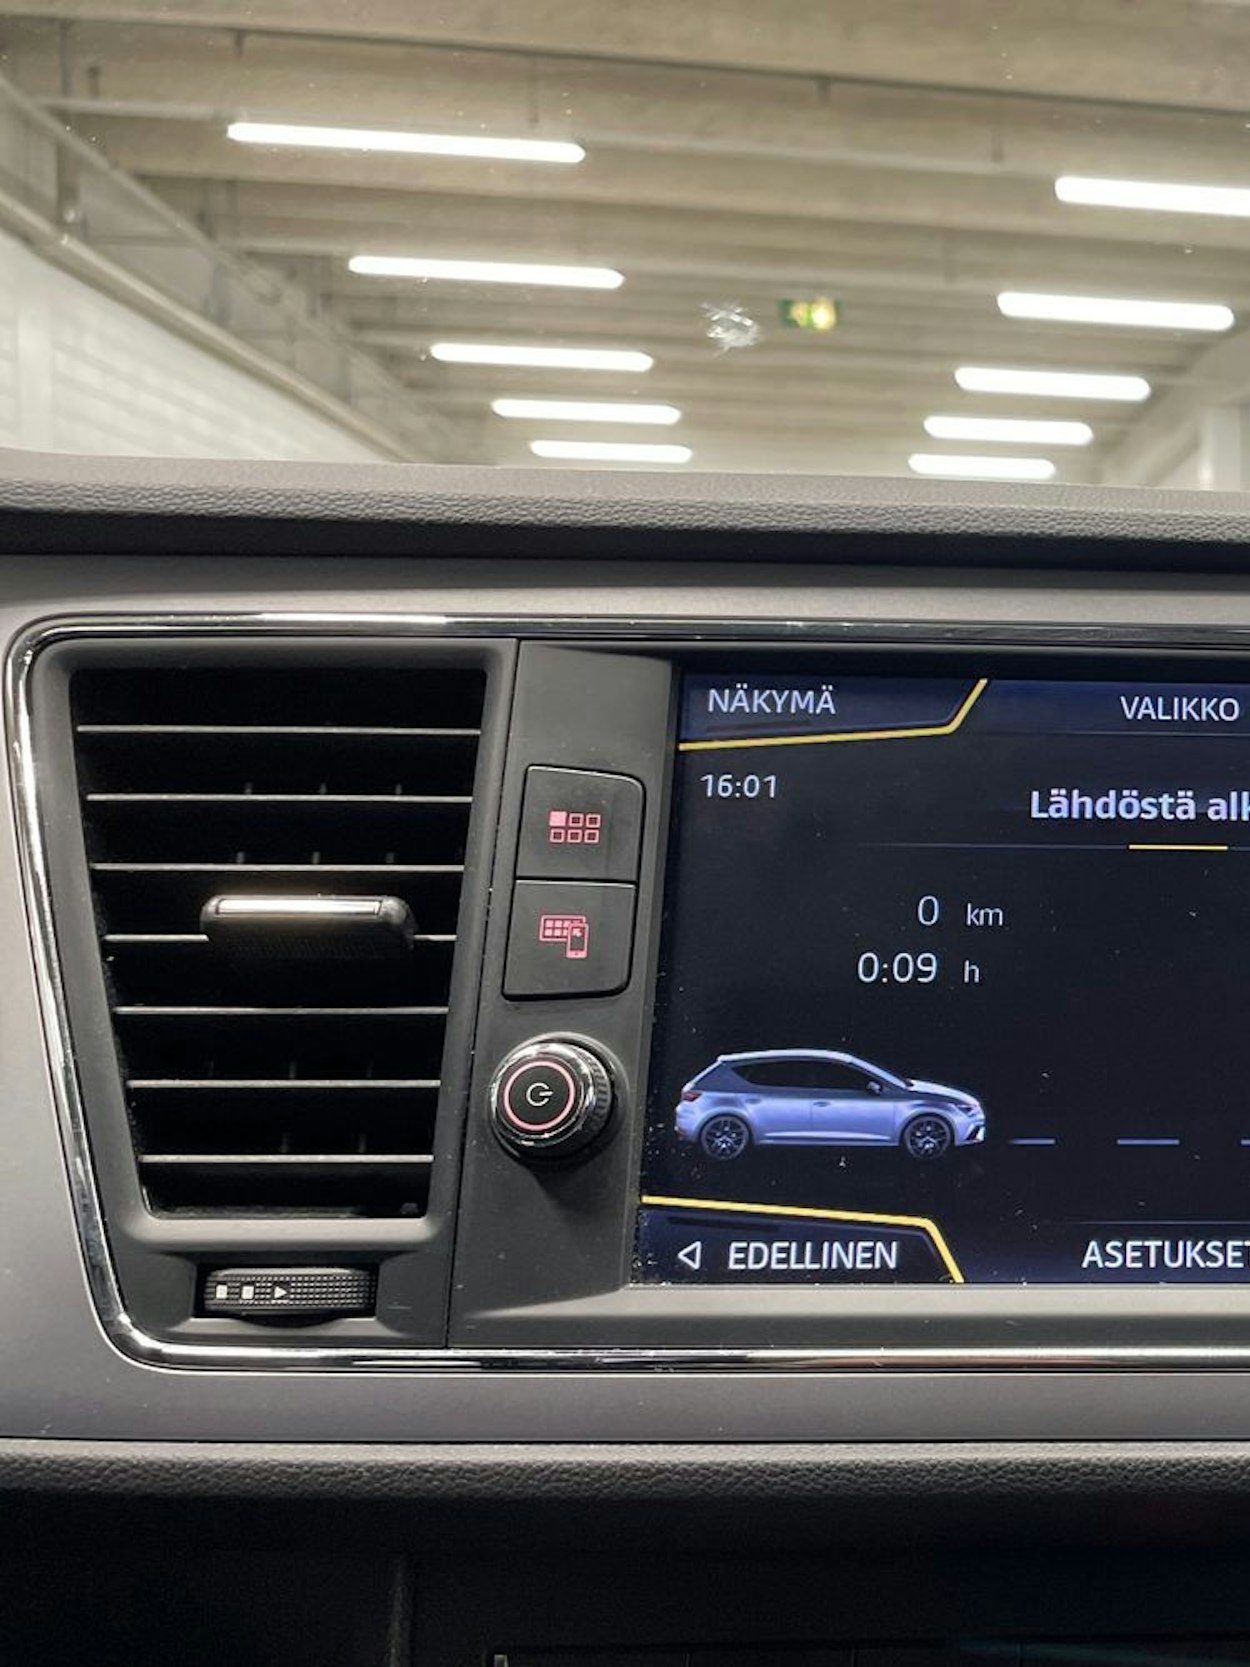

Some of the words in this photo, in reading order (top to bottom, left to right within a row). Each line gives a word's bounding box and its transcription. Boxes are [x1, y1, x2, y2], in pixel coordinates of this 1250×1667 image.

[708, 683, 836, 715] NÄKYMÄ
[1120, 695, 1240, 722] VALIKKO
[700, 774, 777, 798] 16:01
[1031, 788, 1197, 820] Lähdöstä
[917, 895, 940, 926] 0
[966, 902, 1004, 926] km
[857, 952, 938, 983] 0:09
[964, 959, 980, 983] h
[728, 1241, 898, 1270] EDELLINEN
